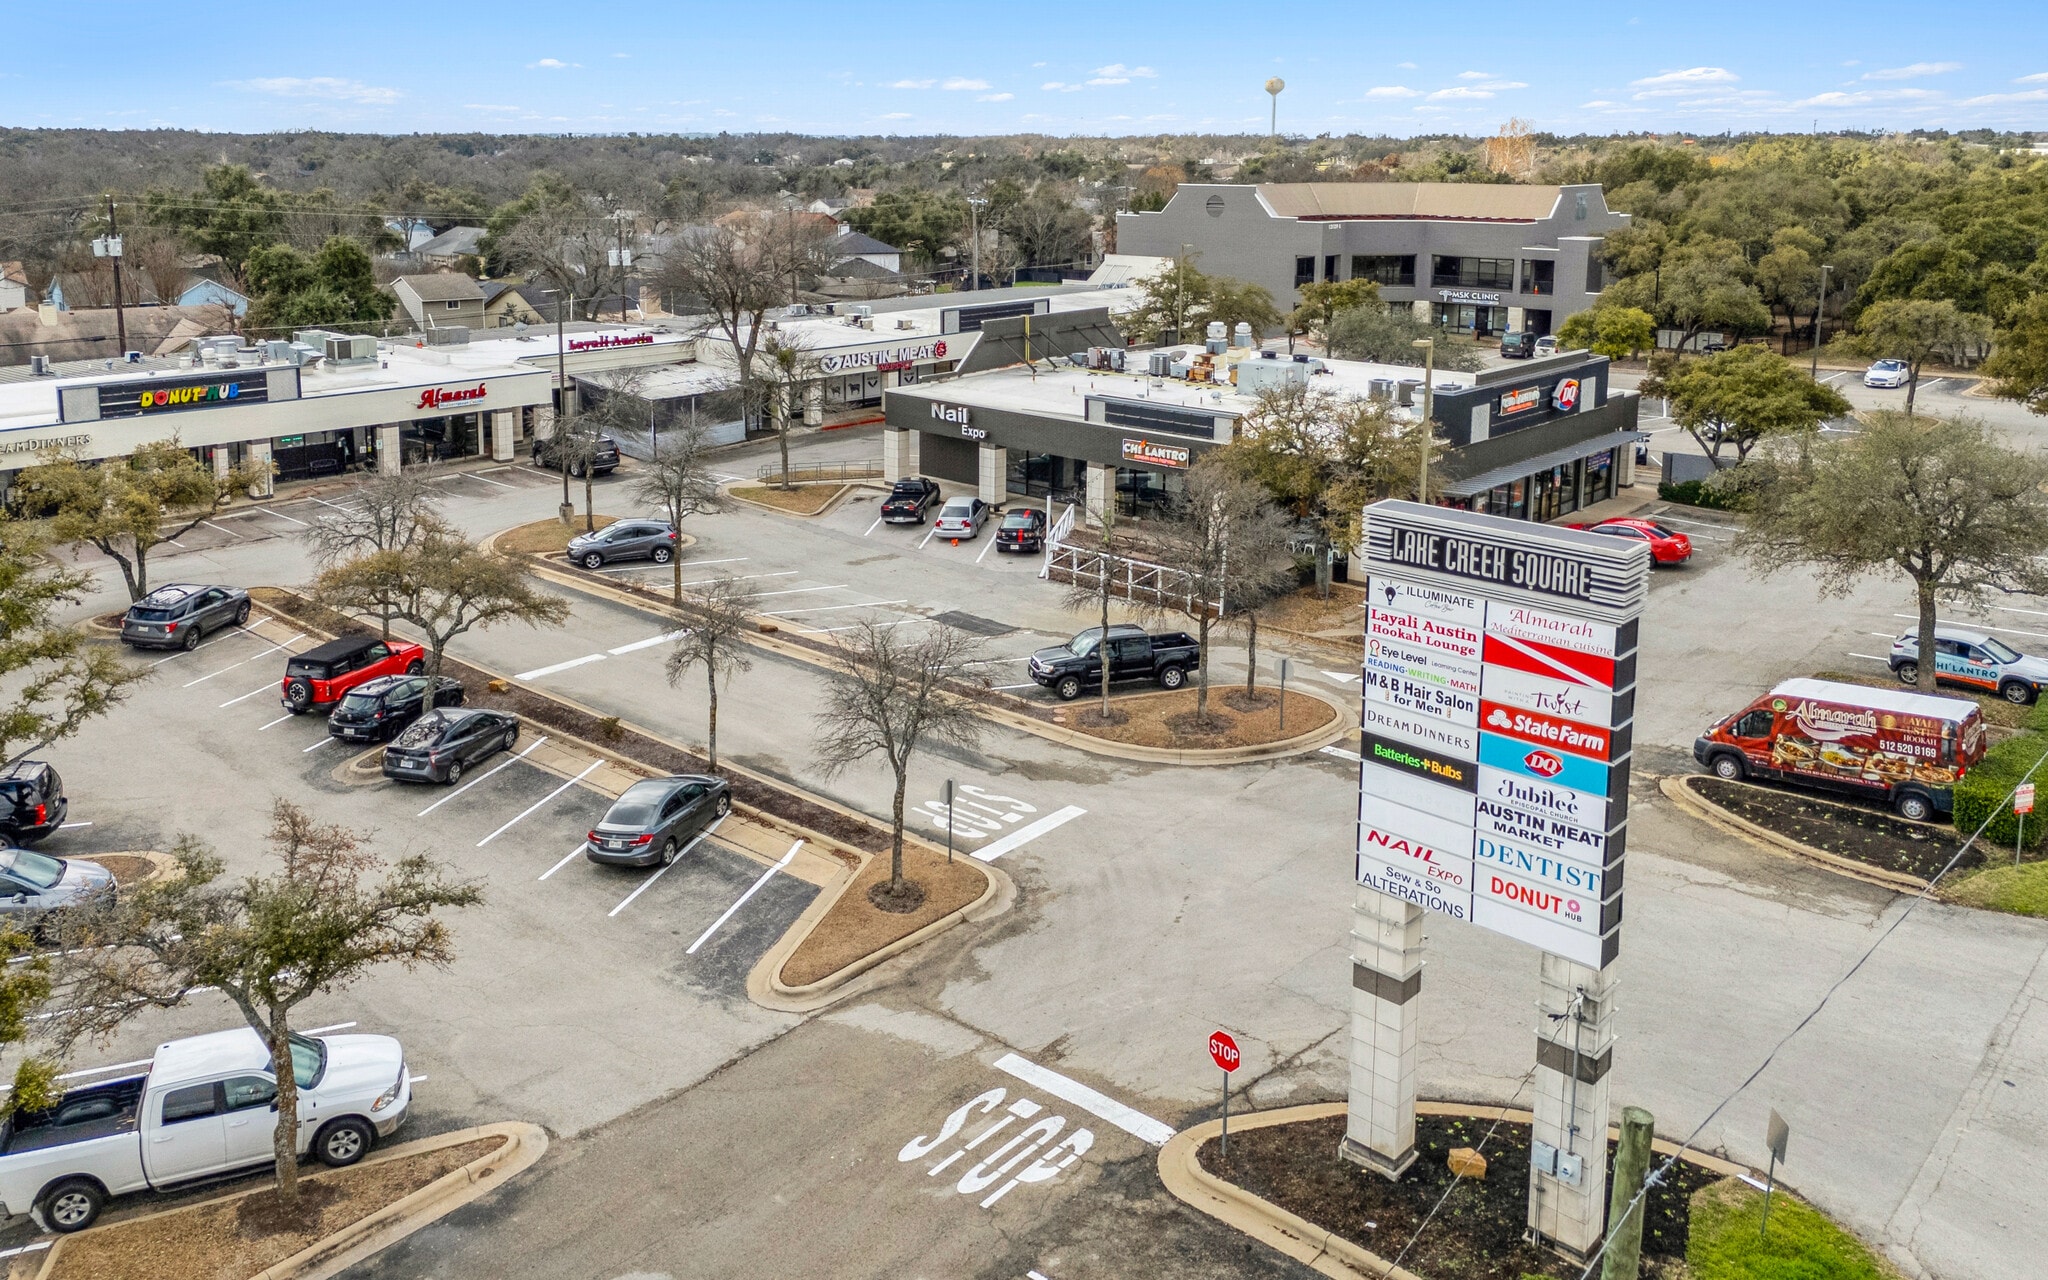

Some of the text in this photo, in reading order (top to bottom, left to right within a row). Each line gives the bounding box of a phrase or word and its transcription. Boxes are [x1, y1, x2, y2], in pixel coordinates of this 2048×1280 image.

[1452, 291, 1500, 301] MSK CLINIC
[842, 345, 934, 369] AUSTIN MEAT
[141, 383, 240, 408] DONUT HUB
[1562, 384, 1578, 403] DQ
[931, 402, 968, 424] Nail
[28, 434, 91, 452] DINNERS
[961, 424, 986, 439] Expo
[1393, 529, 1593, 598] LAKE CREEK SQUARE
[1406, 586, 1475, 609] ILLUMINATE
[1371, 608, 1478, 643] Layali Austin
[1509, 608, 1594, 638] Almarah
[1372, 623, 1476, 657] Hookah Lounge
[1490, 621, 1613, 656] Mediterranean cuisine
[1382, 645, 1478, 677] Eye Level Learning Center
[1936, 661, 1998, 679] HI'LANTRO
[1366, 671, 1474, 713] M & B Hair Salon
[1394, 693, 1442, 715] for Men
[1785, 699, 1877, 730] Almarah
[1367, 710, 1470, 750] DREAM DINNERS
[1903, 734, 1937, 747] HOOKAH
[1879, 739, 1936, 758] 512 520 8169
[1530, 754, 1558, 775] DQ
[1498, 779, 1579, 815] Jubilee
[1478, 800, 1603, 848] AUSTIN MEAT
[1510, 799, 1579, 824] EPISCOPAL CHURCH
[1367, 829, 1441, 866] NAIL
[1493, 821, 1565, 850] MARKET
[1427, 866, 1463, 886] EXPO
[1478, 838, 1601, 892] DENTIST
[1386, 866, 1441, 894] Sew & So
[1362, 872, 1464, 919] ALTERATIONS
[1491, 876, 1563, 915] DONUT
[1564, 911, 1582, 923] HUB
[1210, 1039, 1239, 1064] STOP
[898, 1086, 1094, 1209] STOP
